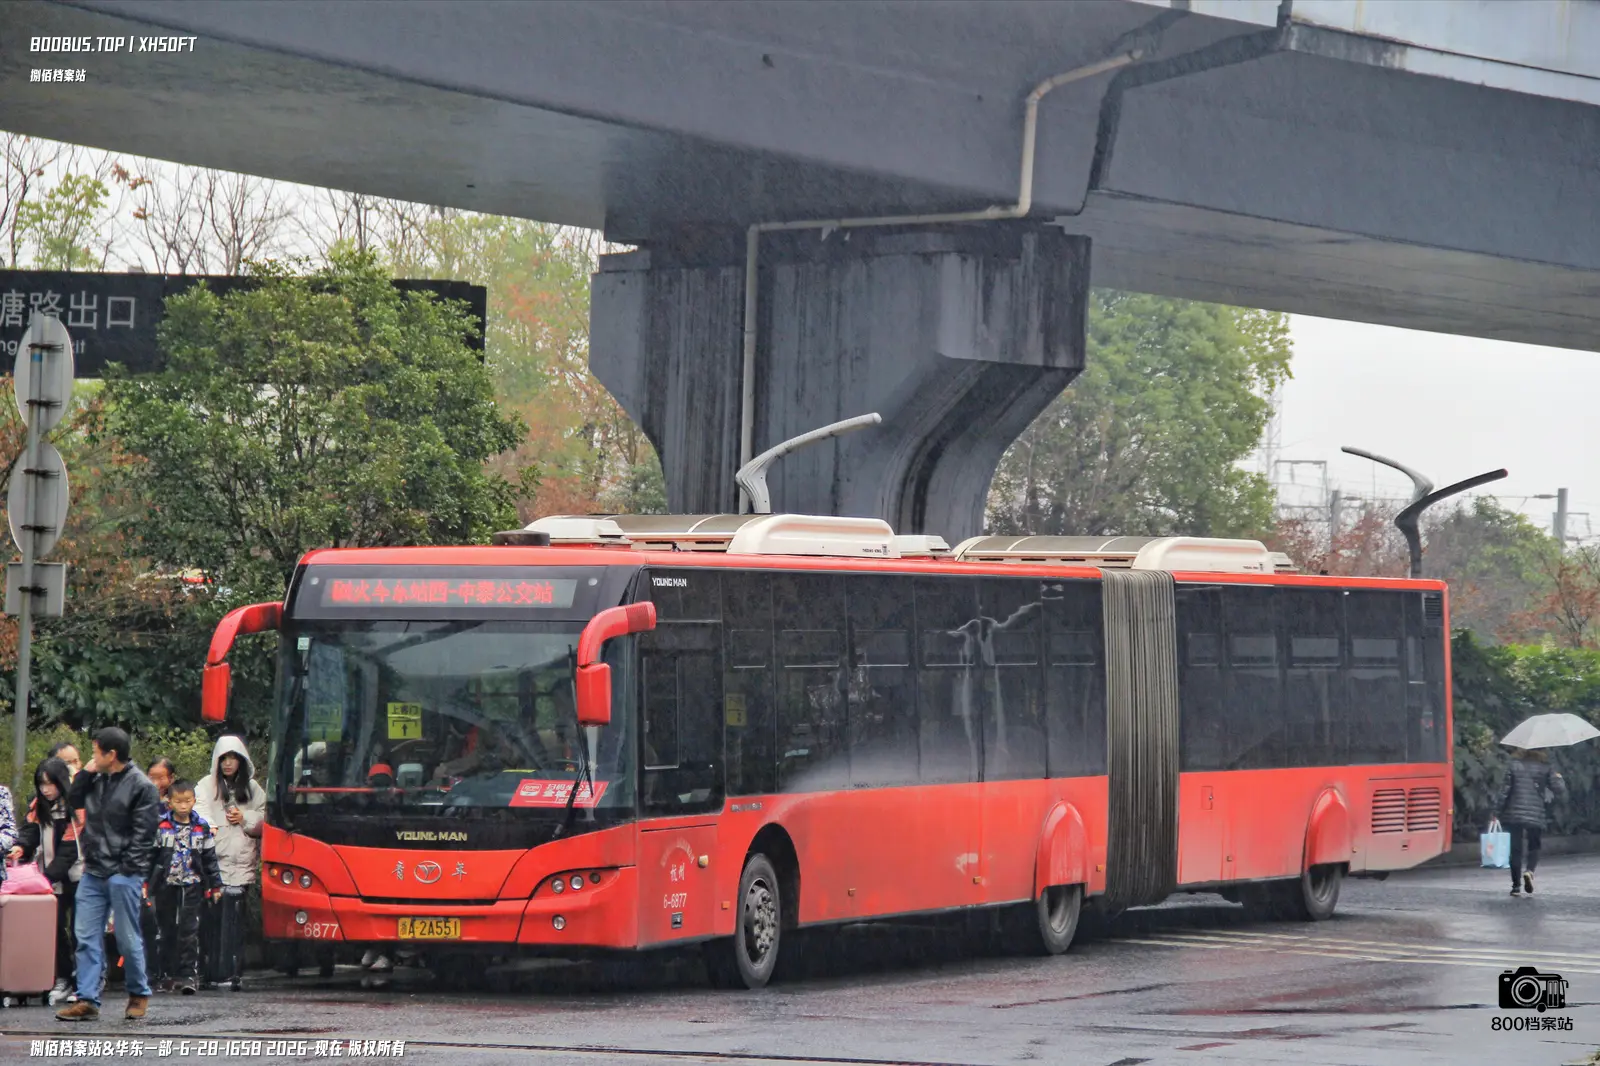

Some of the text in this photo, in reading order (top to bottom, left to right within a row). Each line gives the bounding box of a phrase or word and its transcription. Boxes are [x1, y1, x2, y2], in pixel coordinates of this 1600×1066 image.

[652, 577, 687, 587] YOUNG MAN
[396, 831, 467, 842] YOUNG MAN
[663, 893, 687, 908] 6-6877
